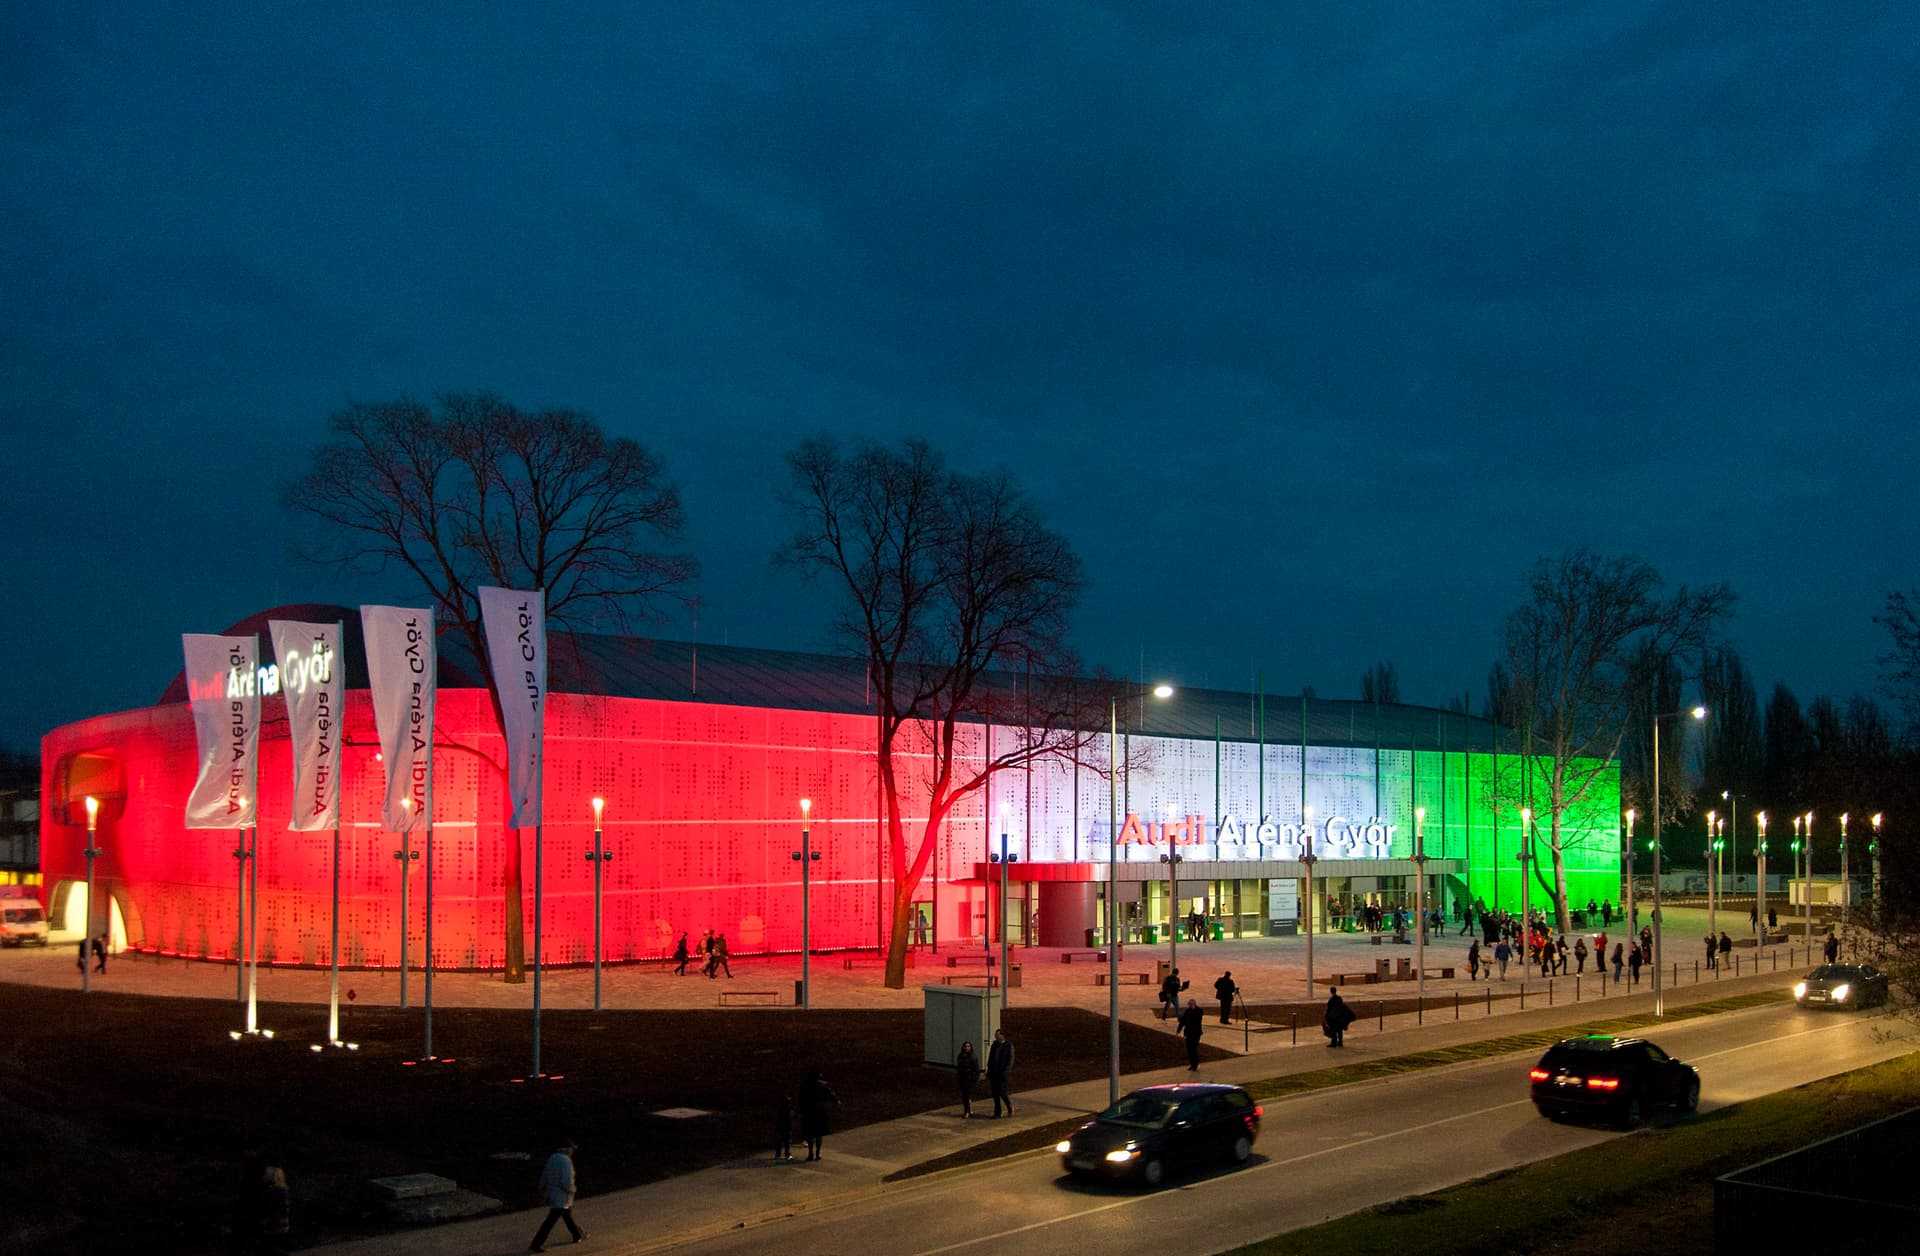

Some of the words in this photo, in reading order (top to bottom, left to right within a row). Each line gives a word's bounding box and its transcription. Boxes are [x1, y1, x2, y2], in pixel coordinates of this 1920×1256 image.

[1116, 813, 1206, 846] Audi
[1215, 814, 1315, 848] Aréna
[1325, 816, 1398, 851] Győr
